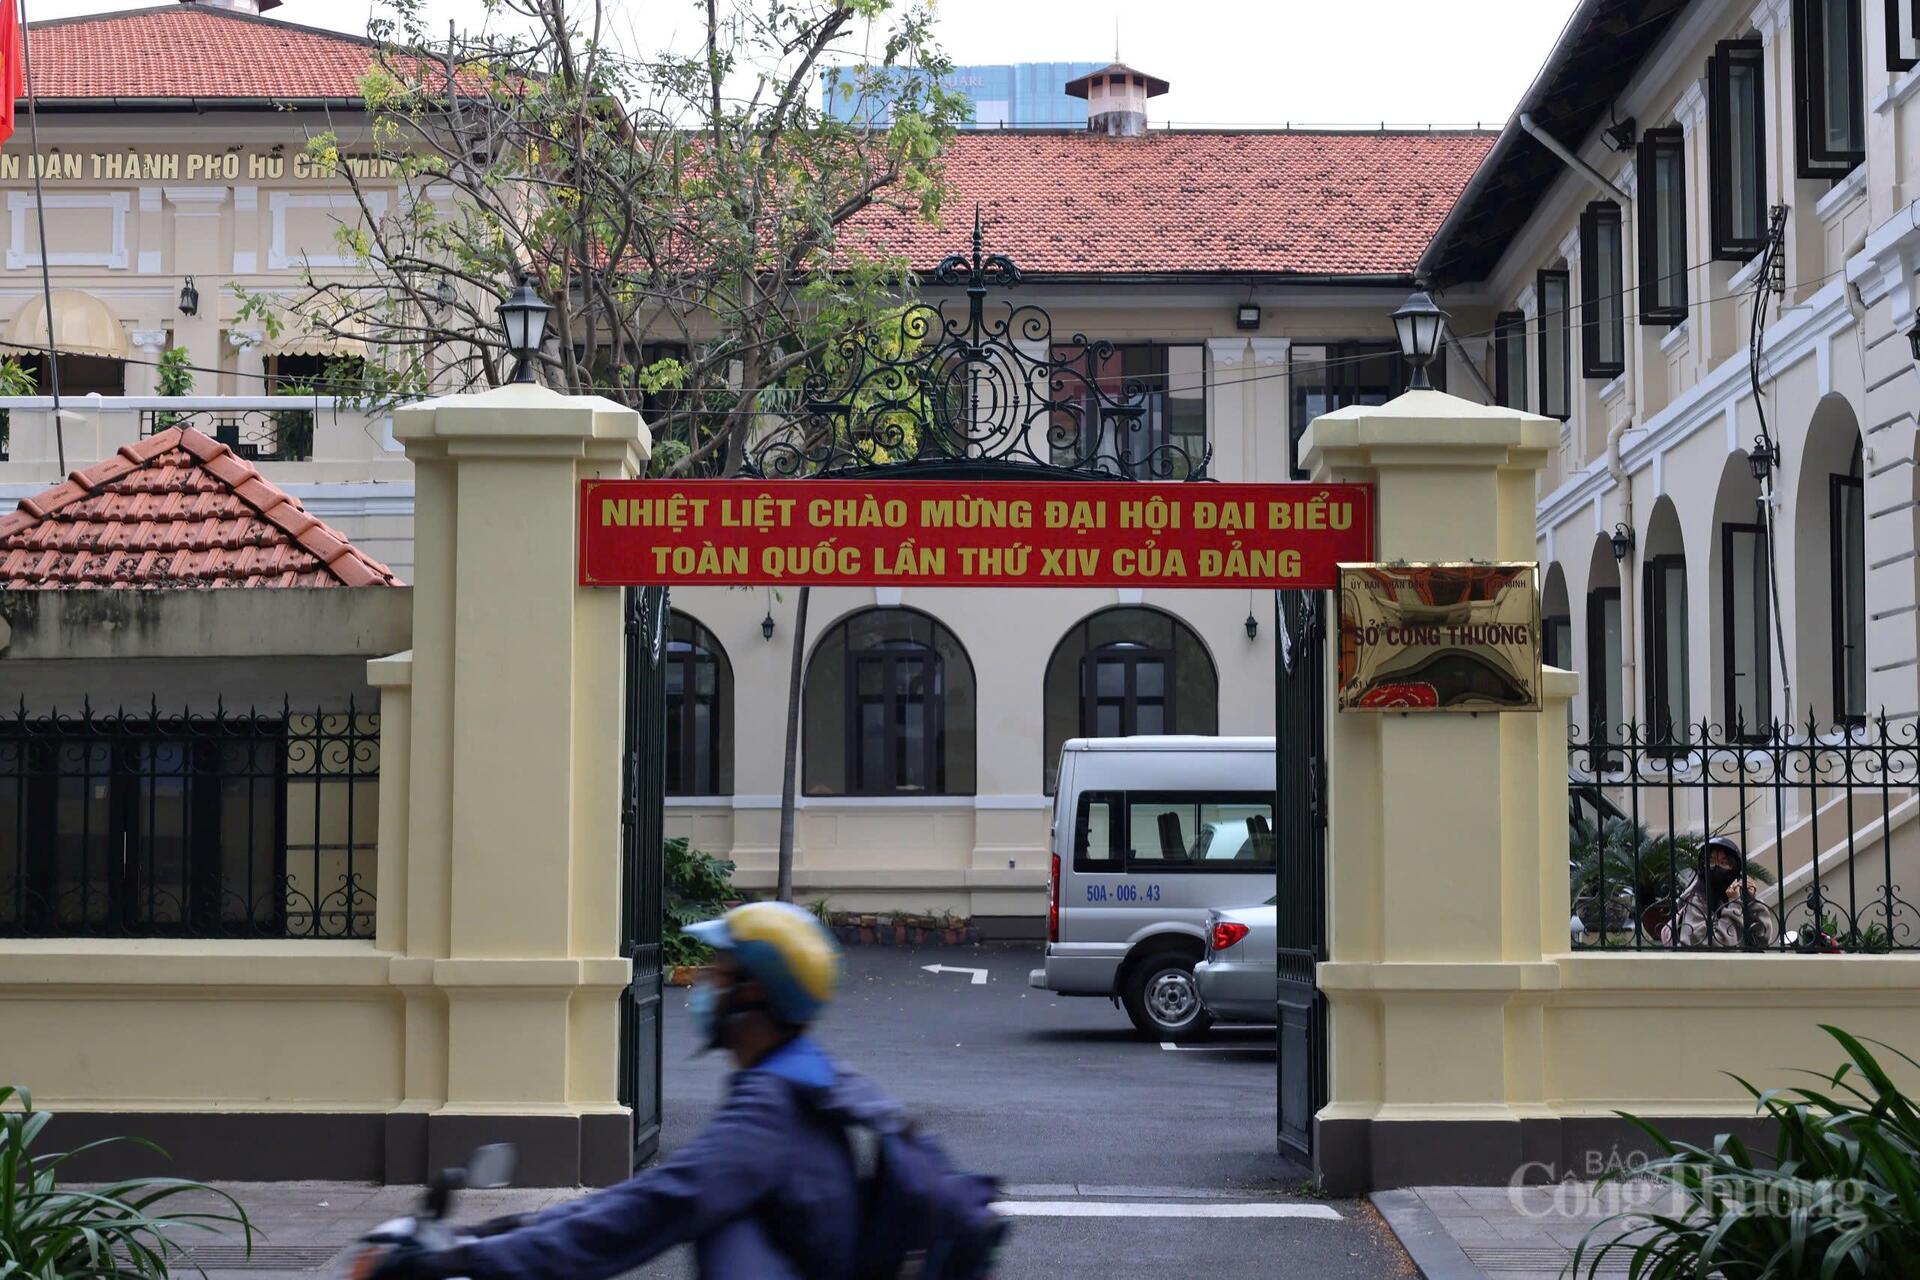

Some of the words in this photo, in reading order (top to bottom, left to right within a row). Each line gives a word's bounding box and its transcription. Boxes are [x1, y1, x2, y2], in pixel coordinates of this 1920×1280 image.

[91, 147, 179, 179] THÀNH
[602, 493, 709, 532] NHIỆT
[721, 493, 796, 532] LIỆT
[808, 494, 907, 527] CHÀO
[921, 494, 1032, 528] MỪNG
[1044, 501, 1106, 534] ĐẠI
[1119, 496, 1181, 534] HỘI
[1193, 502, 1255, 535] ĐẠI
[1269, 491, 1352, 530] BIỂU
[651, 541, 749, 574] TOÀN
[762, 537, 861, 577] QUỐC
[874, 537, 945, 575] LẦN
[957, 542, 1032, 576] THỨ
[1040, 549, 1100, 576] XIV
[1112, 540, 1187, 577] CỦA
[1199, 540, 1301, 578] ĐẢNG
[1355, 618, 1379, 646] SỞ
[1444, 622, 1528, 646] THƯƠNG
